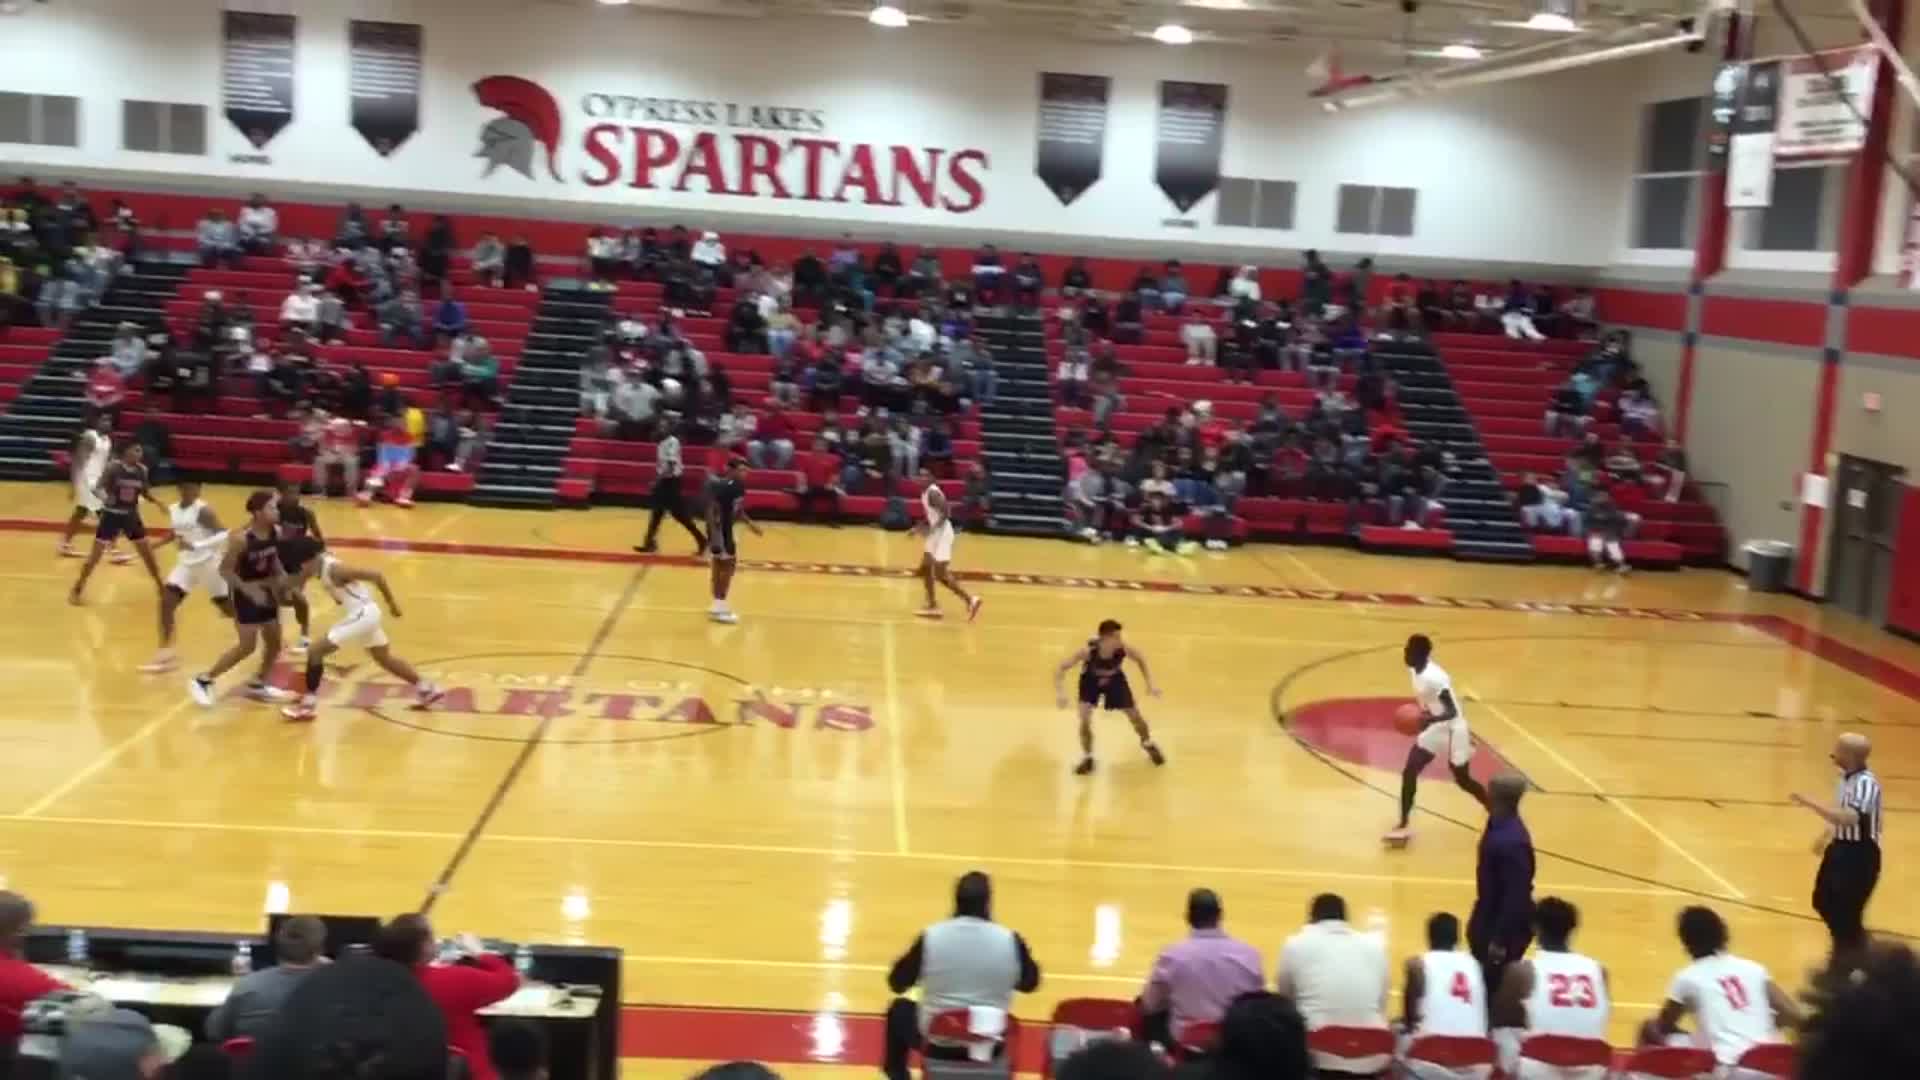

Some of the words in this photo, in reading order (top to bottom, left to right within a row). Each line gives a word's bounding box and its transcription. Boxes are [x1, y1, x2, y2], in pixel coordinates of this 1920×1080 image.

[581, 92, 718, 126] CYPRESS
[725, 99, 826, 131] LAKES
[580, 123, 990, 214] SPARTANS
[268, 668, 876, 731] PARTANS
[1450, 971, 1472, 1004] 4
[1547, 973, 1597, 1009] 23
